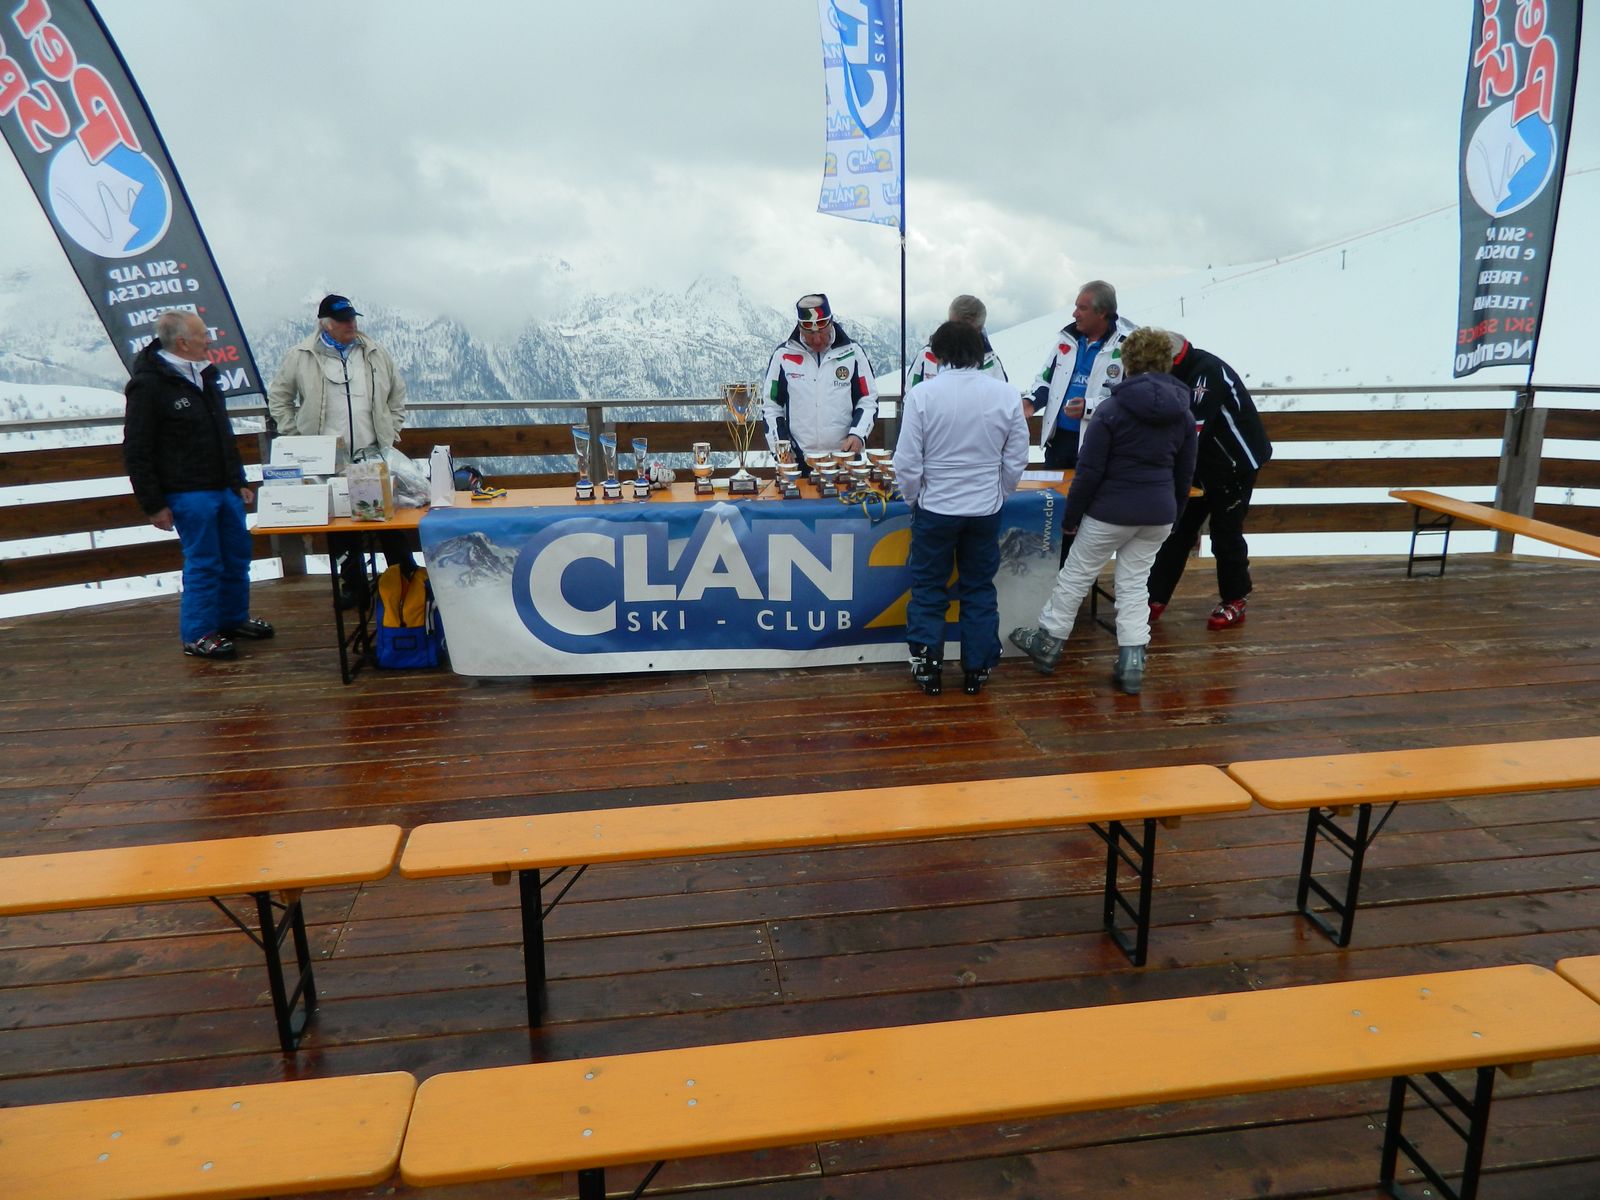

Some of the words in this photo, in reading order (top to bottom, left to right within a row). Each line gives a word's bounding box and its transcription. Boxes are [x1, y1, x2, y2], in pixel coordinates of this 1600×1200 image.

[874, 19, 886, 63] SKI
[529, 513, 854, 636] CLAN
[627, 610, 686, 632] SKI
[757, 609, 852, 631] CLUB
